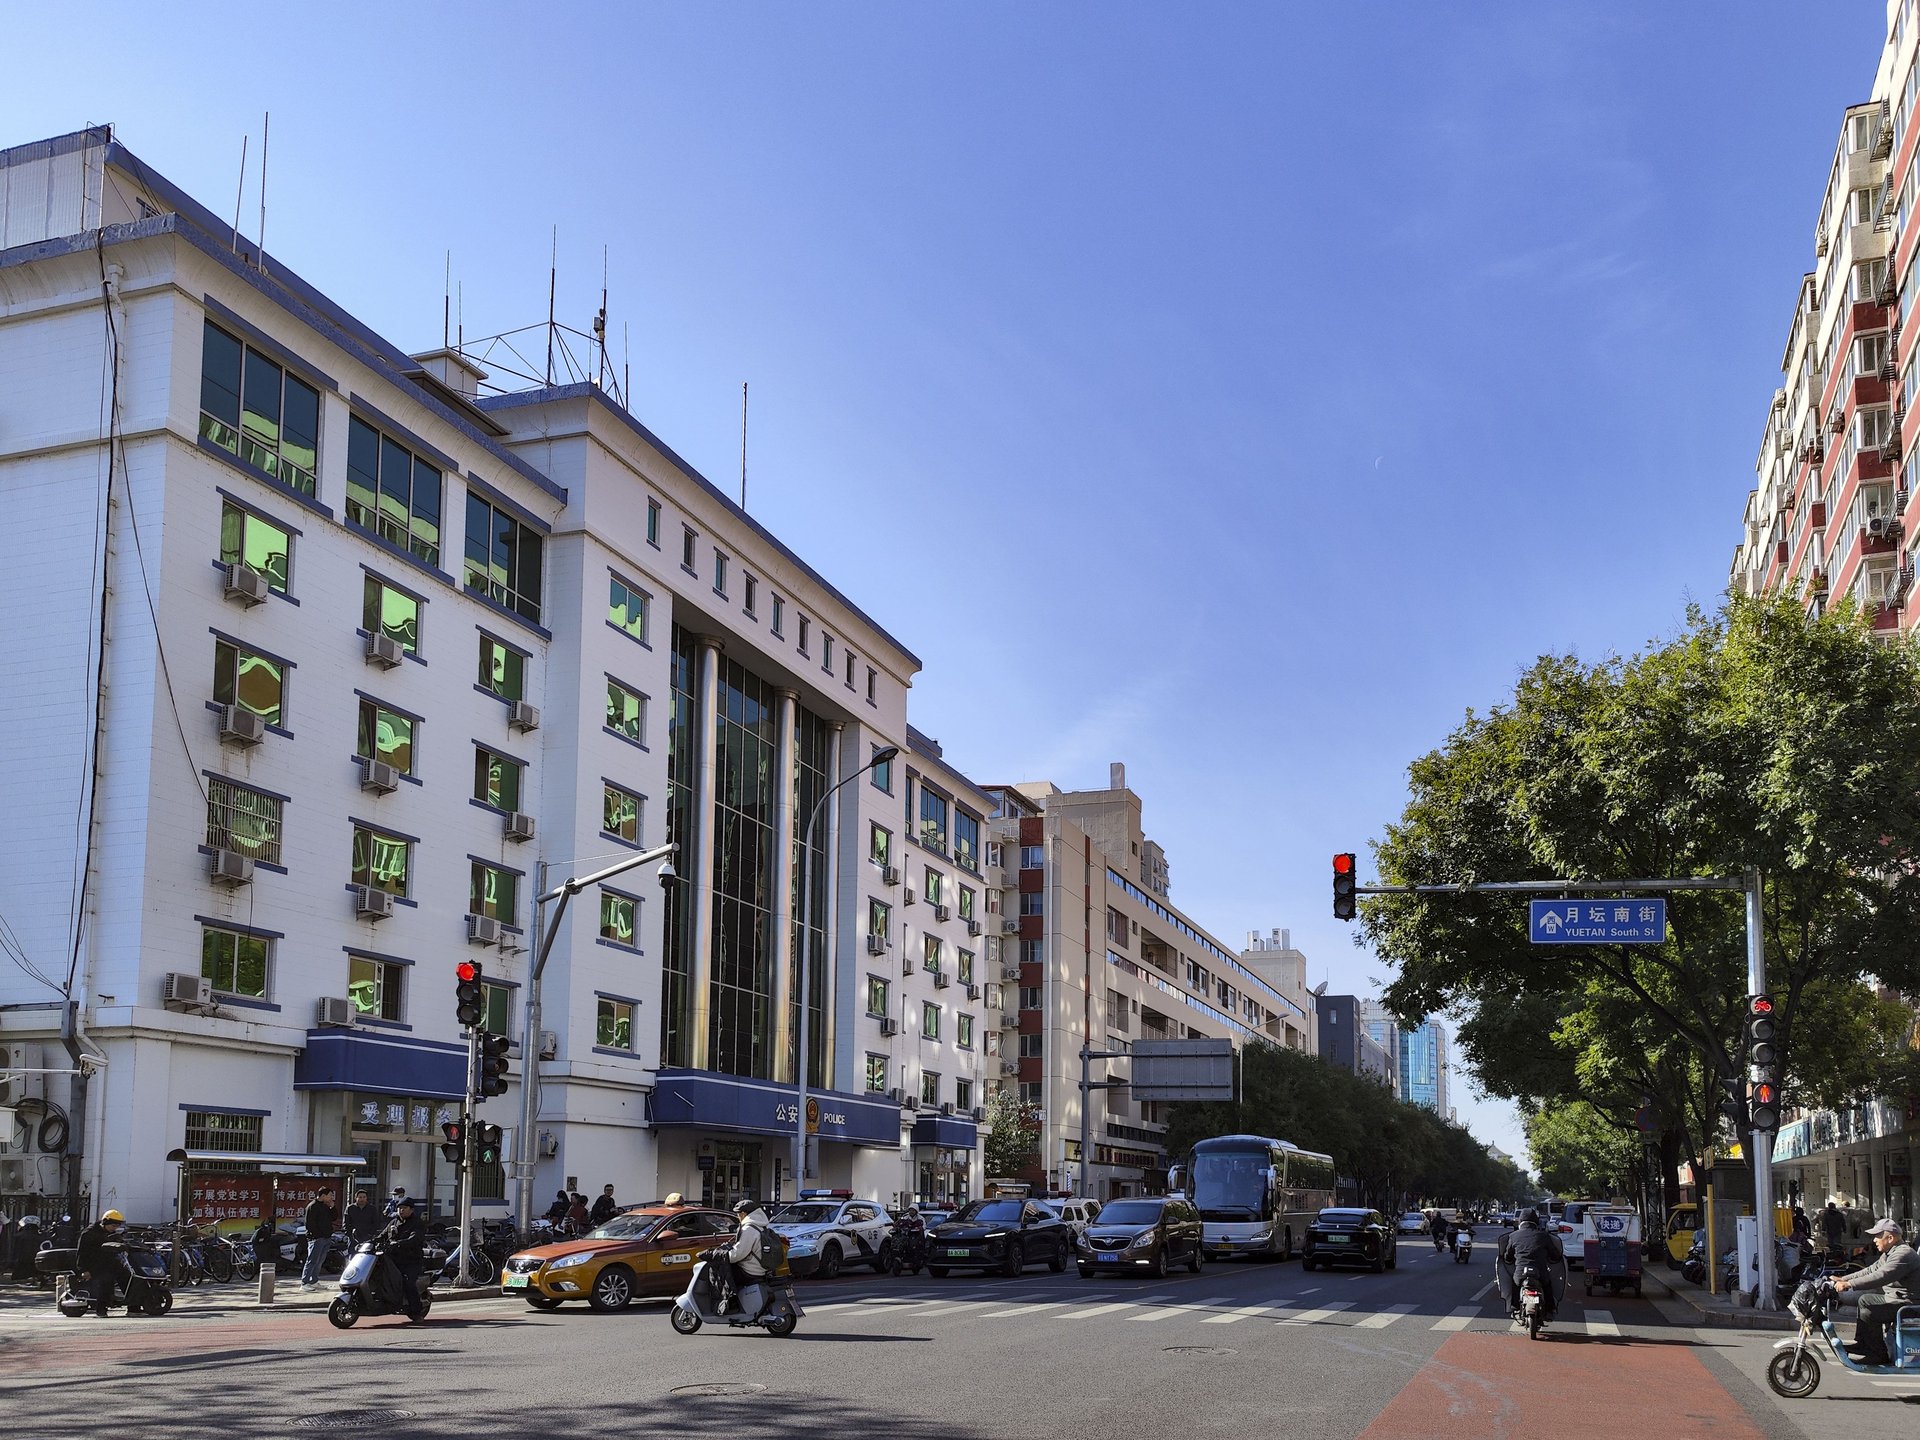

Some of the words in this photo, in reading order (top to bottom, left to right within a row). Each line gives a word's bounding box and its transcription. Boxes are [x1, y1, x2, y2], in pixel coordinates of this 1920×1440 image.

[1565, 906, 1656, 923] 月坛南街
[1547, 925, 1555, 933] W
[1565, 927, 1606, 937] YUETAN
[1610, 927, 1639, 937] South
[1644, 927, 1655, 937] St
[775, 1103, 799, 1124] 公安
[823, 1112, 846, 1125] POLICE
[193, 1189, 260, 1201] 开展党史学习
[192, 1206, 260, 1218] 加强队伍管理
[1600, 1219, 1621, 1230] 快递
[867, 1230, 879, 1240] 公安
